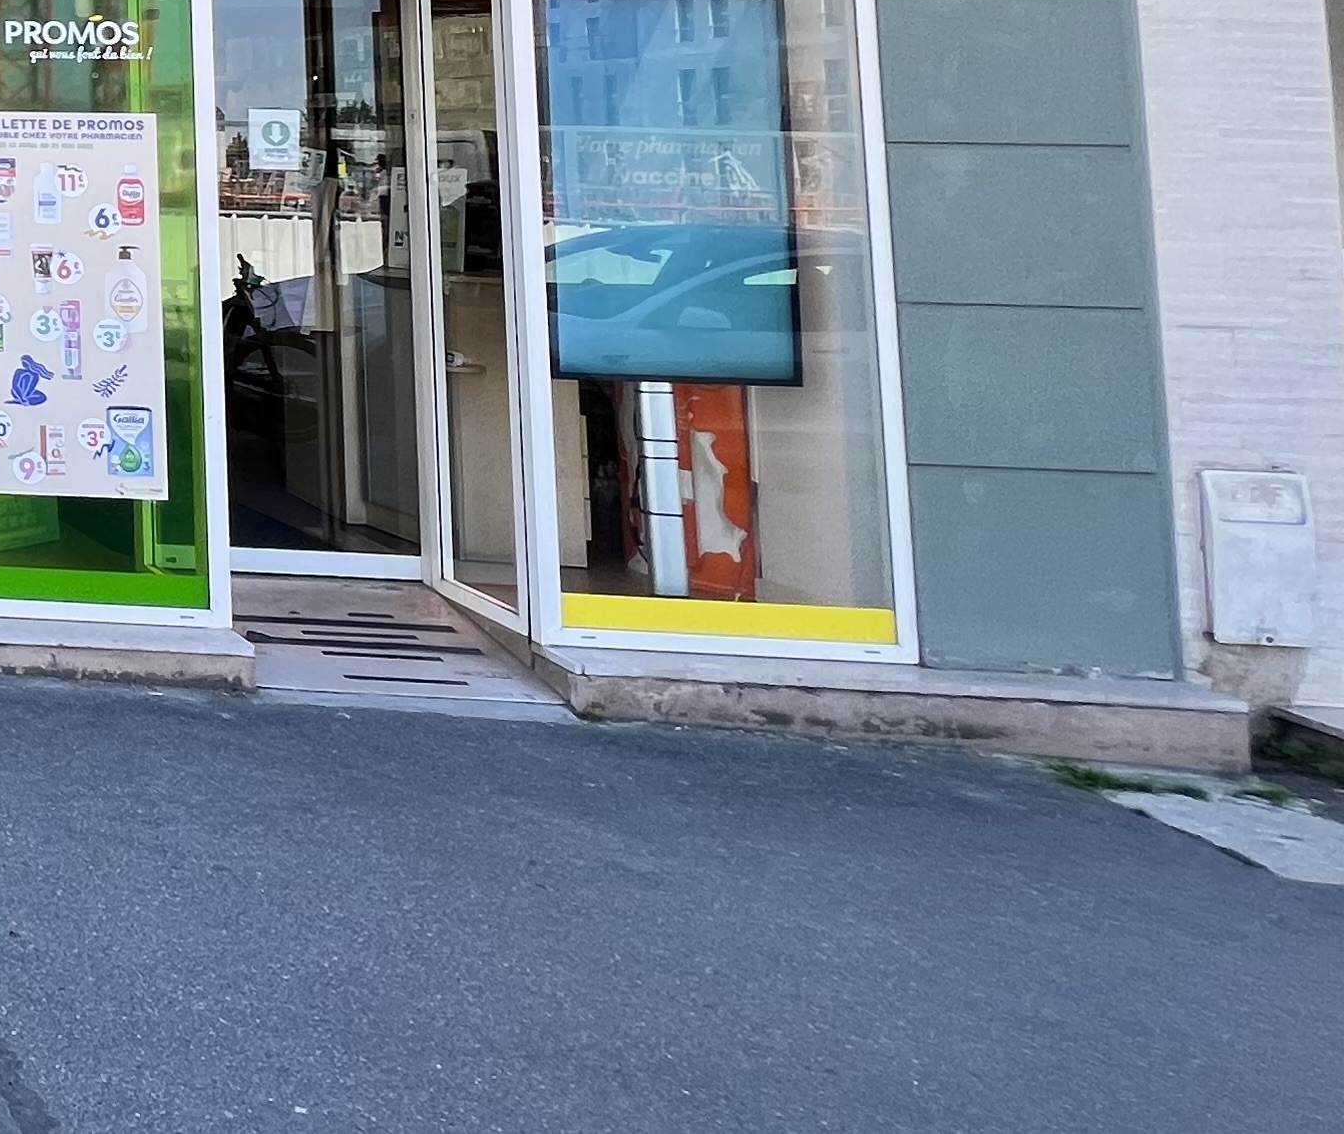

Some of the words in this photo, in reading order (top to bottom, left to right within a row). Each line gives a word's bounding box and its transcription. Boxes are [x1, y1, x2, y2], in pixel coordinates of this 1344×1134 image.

[5, 21, 140, 45] PROMOS
[52, 119, 72, 130] DE
[77, 120, 144, 131] PROMOS
